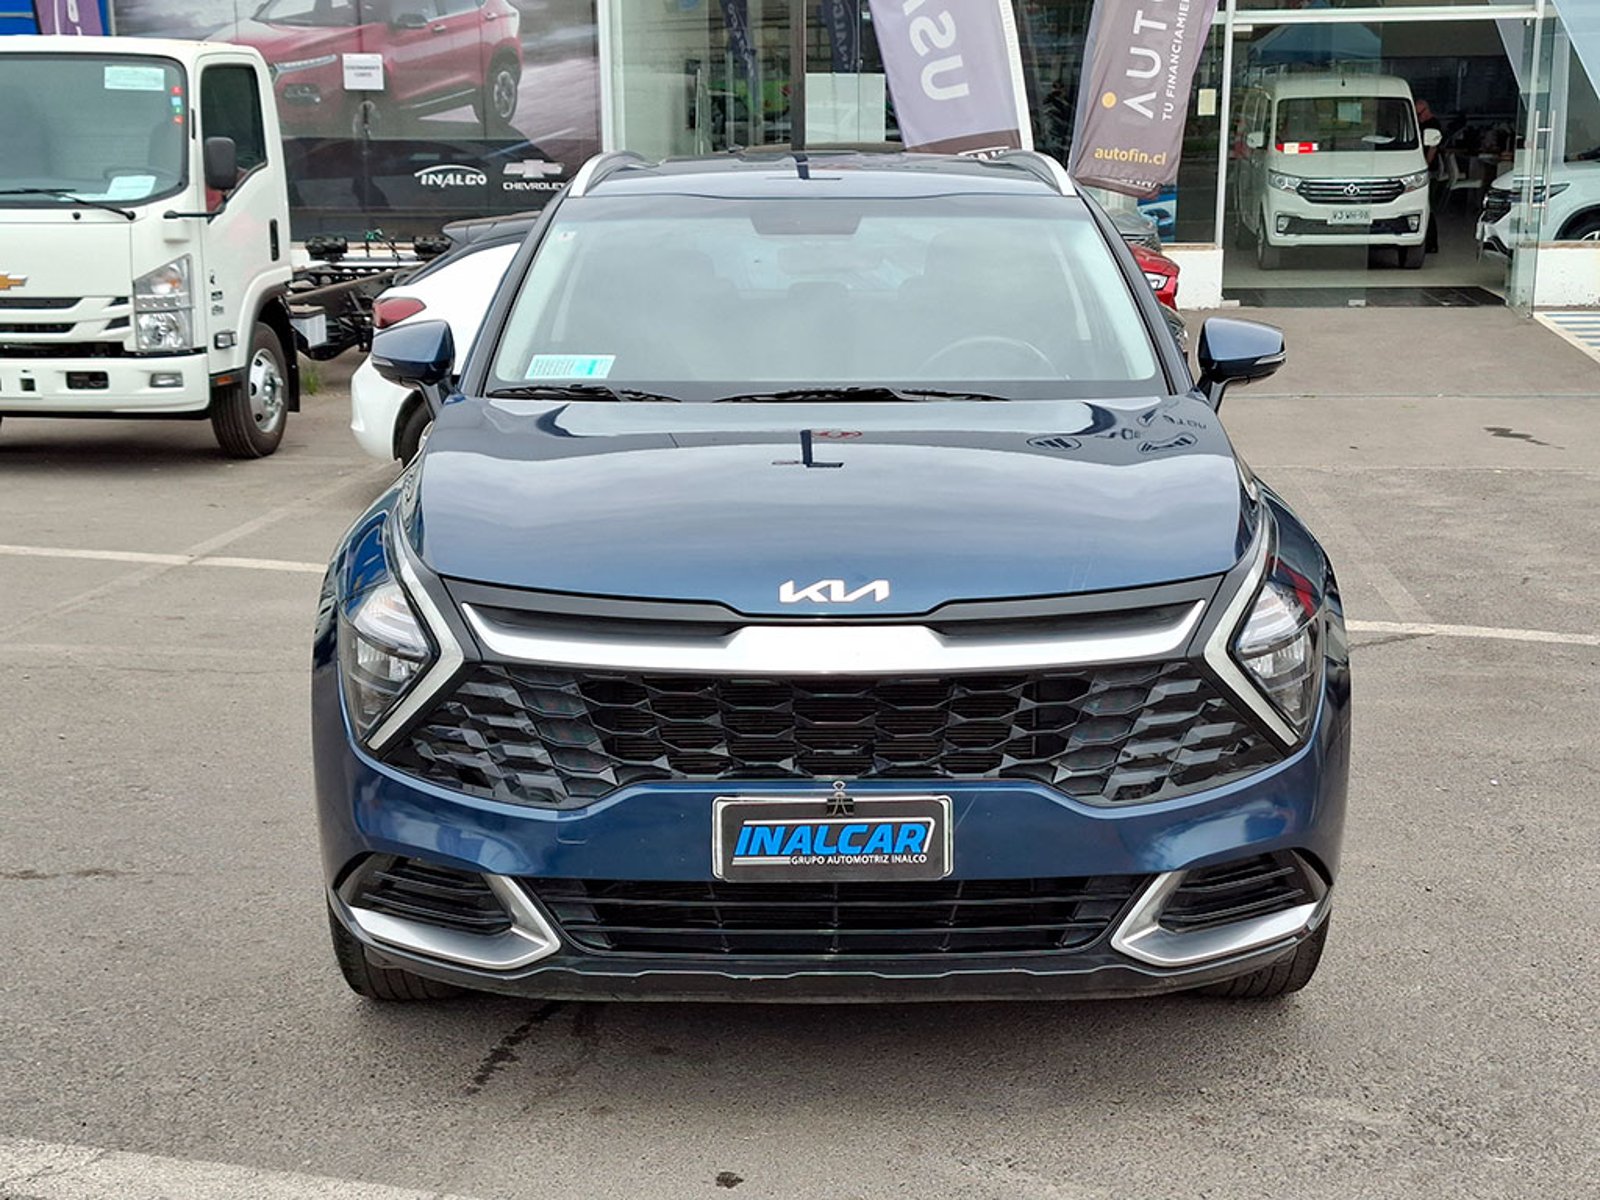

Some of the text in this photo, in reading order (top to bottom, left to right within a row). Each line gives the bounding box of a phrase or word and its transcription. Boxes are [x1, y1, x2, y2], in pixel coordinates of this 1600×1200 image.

[1123, 0, 1168, 119] AUT
[1162, 102, 1175, 121] TU
[1094, 147, 1167, 165] autofin.cl
[420, 171, 488, 189] INALCO
[779, 579, 890, 602] KIA
[734, 823, 927, 856] INALCAR
[791, 854, 927, 865] GRUPO AUTOMOTRIZ INALCO
